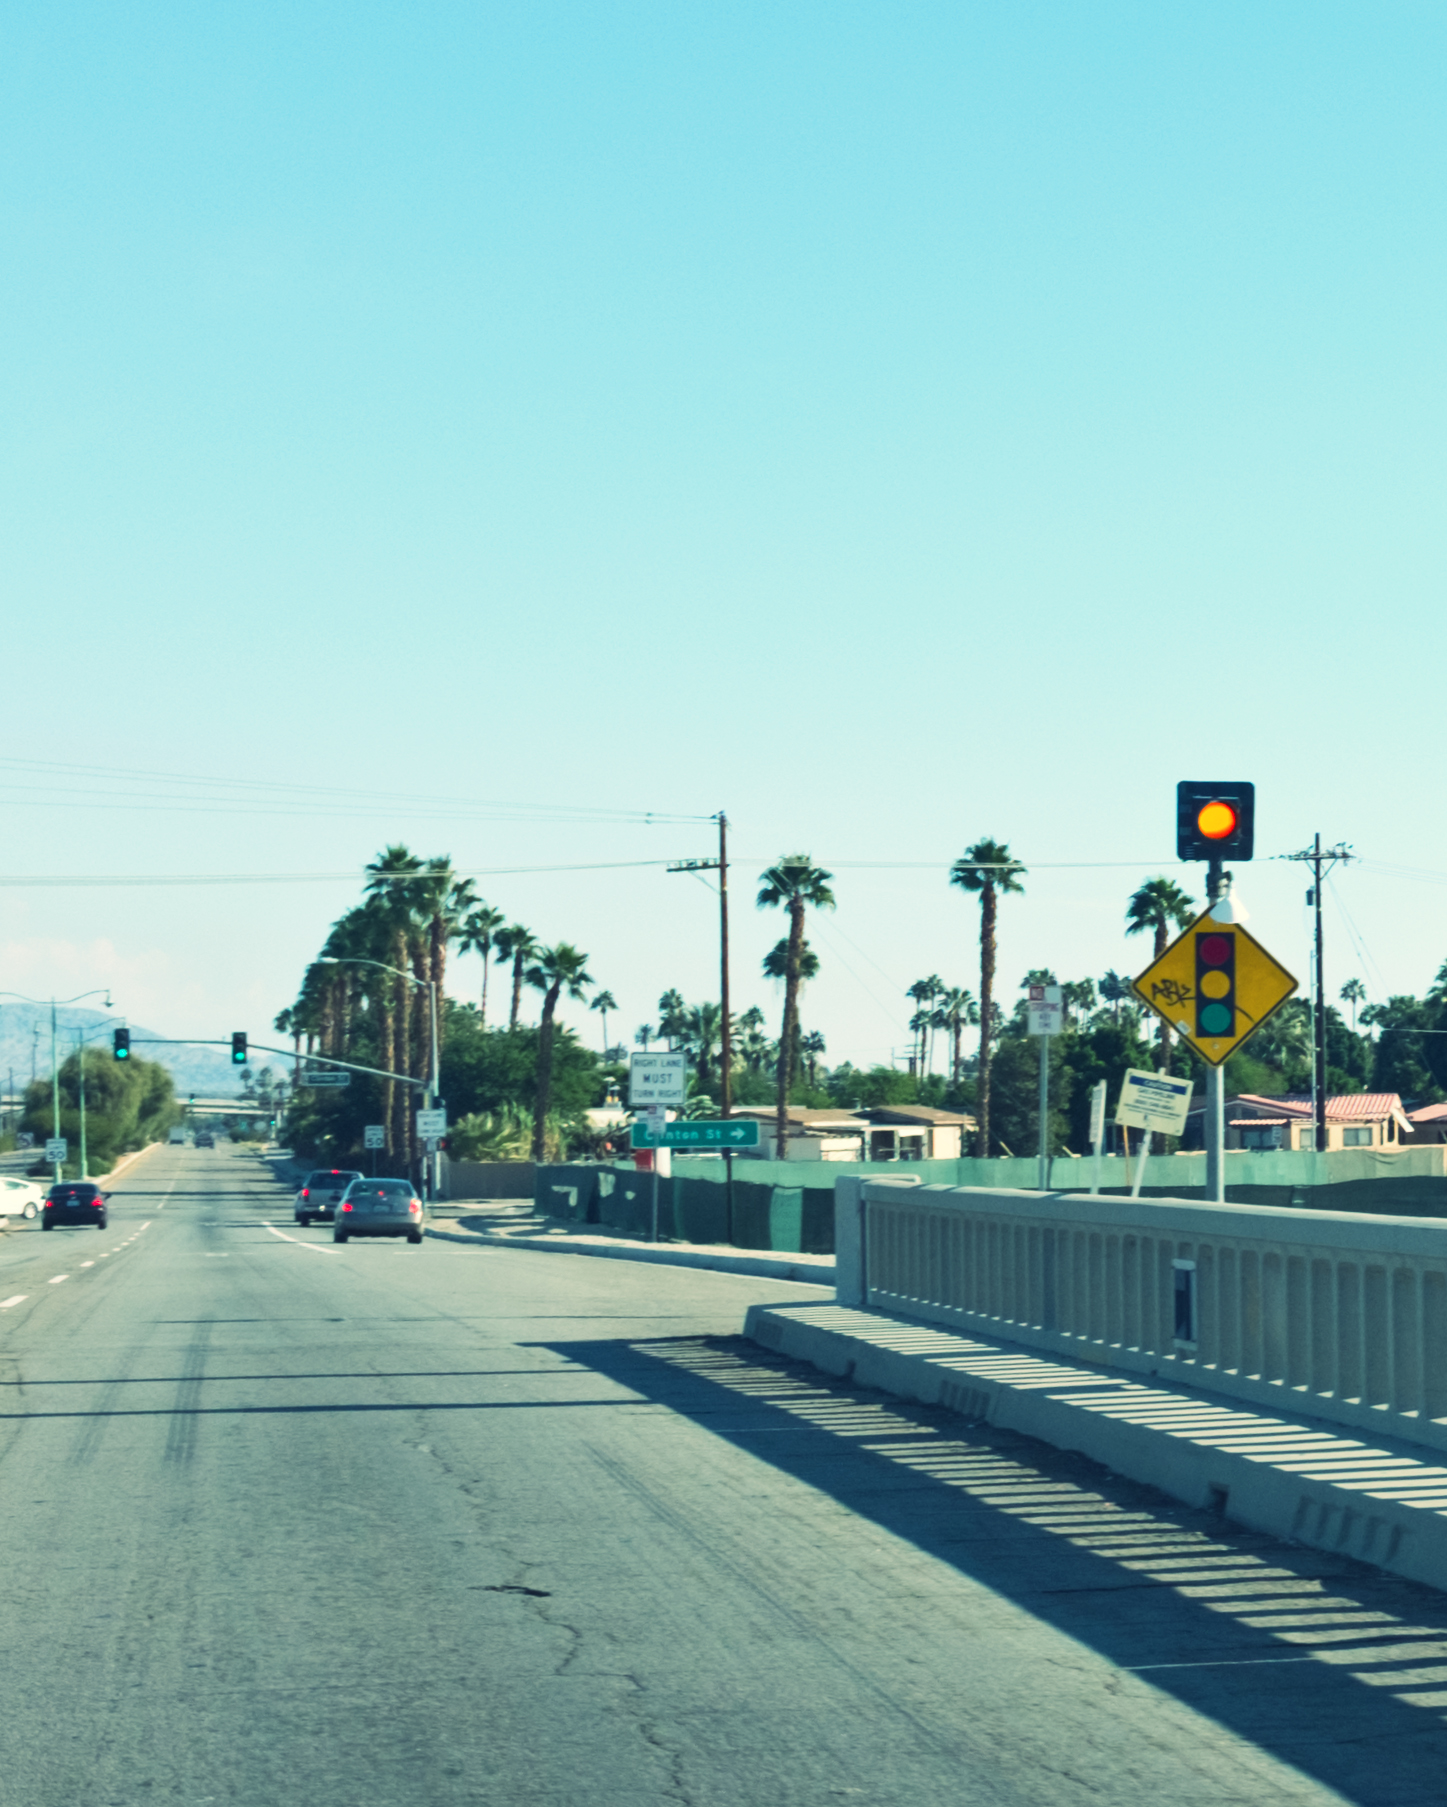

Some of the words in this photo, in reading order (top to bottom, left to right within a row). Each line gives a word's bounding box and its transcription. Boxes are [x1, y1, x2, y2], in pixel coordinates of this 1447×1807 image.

[633, 1058, 658, 1068] RIGHT
[660, 1058, 683, 1068] LANE
[642, 1073, 673, 1084] MUST
[633, 1089, 655, 1098] TURN
[658, 1089, 683, 1098] RIGHT
[706, 1128, 722, 1140] St
[366, 1137, 383, 1147] 50
[48, 1150, 66, 1160] 50
